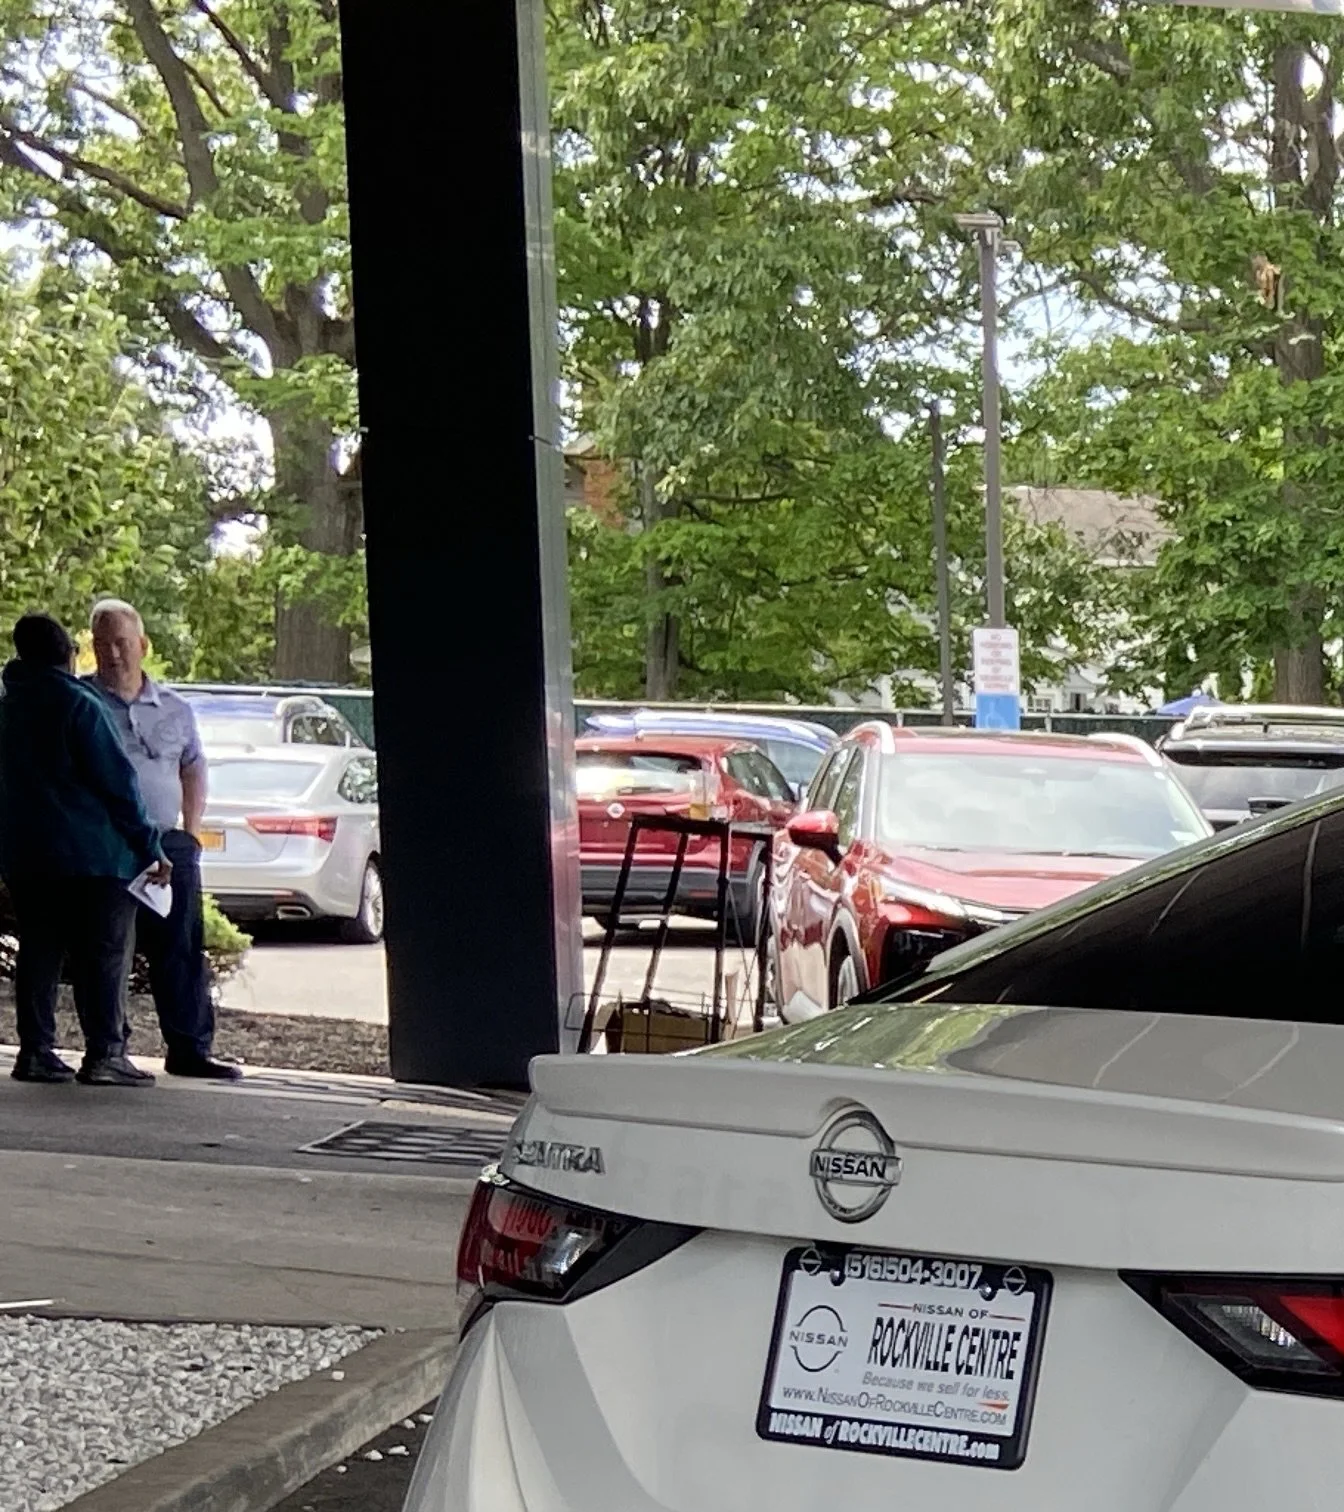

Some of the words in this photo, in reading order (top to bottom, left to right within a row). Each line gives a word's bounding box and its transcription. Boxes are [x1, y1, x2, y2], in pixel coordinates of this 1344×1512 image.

[815, 1155, 887, 1178] NISSAN
[912, 1303, 964, 1318] NISSAN
[968, 1309, 989, 1319] OF
[789, 1330, 848, 1348] NISSAN
[867, 1316, 956, 1373] ROCKVILLE
[955, 1324, 1022, 1380] CENTRE
[862, 1371, 914, 1391] Because
[916, 1381, 934, 1393] we
[937, 1382, 961, 1395] sell
[961, 1382, 980, 1398] for
[768, 1411, 823, 1438] NISSAN
[823, 1420, 840, 1444] of
